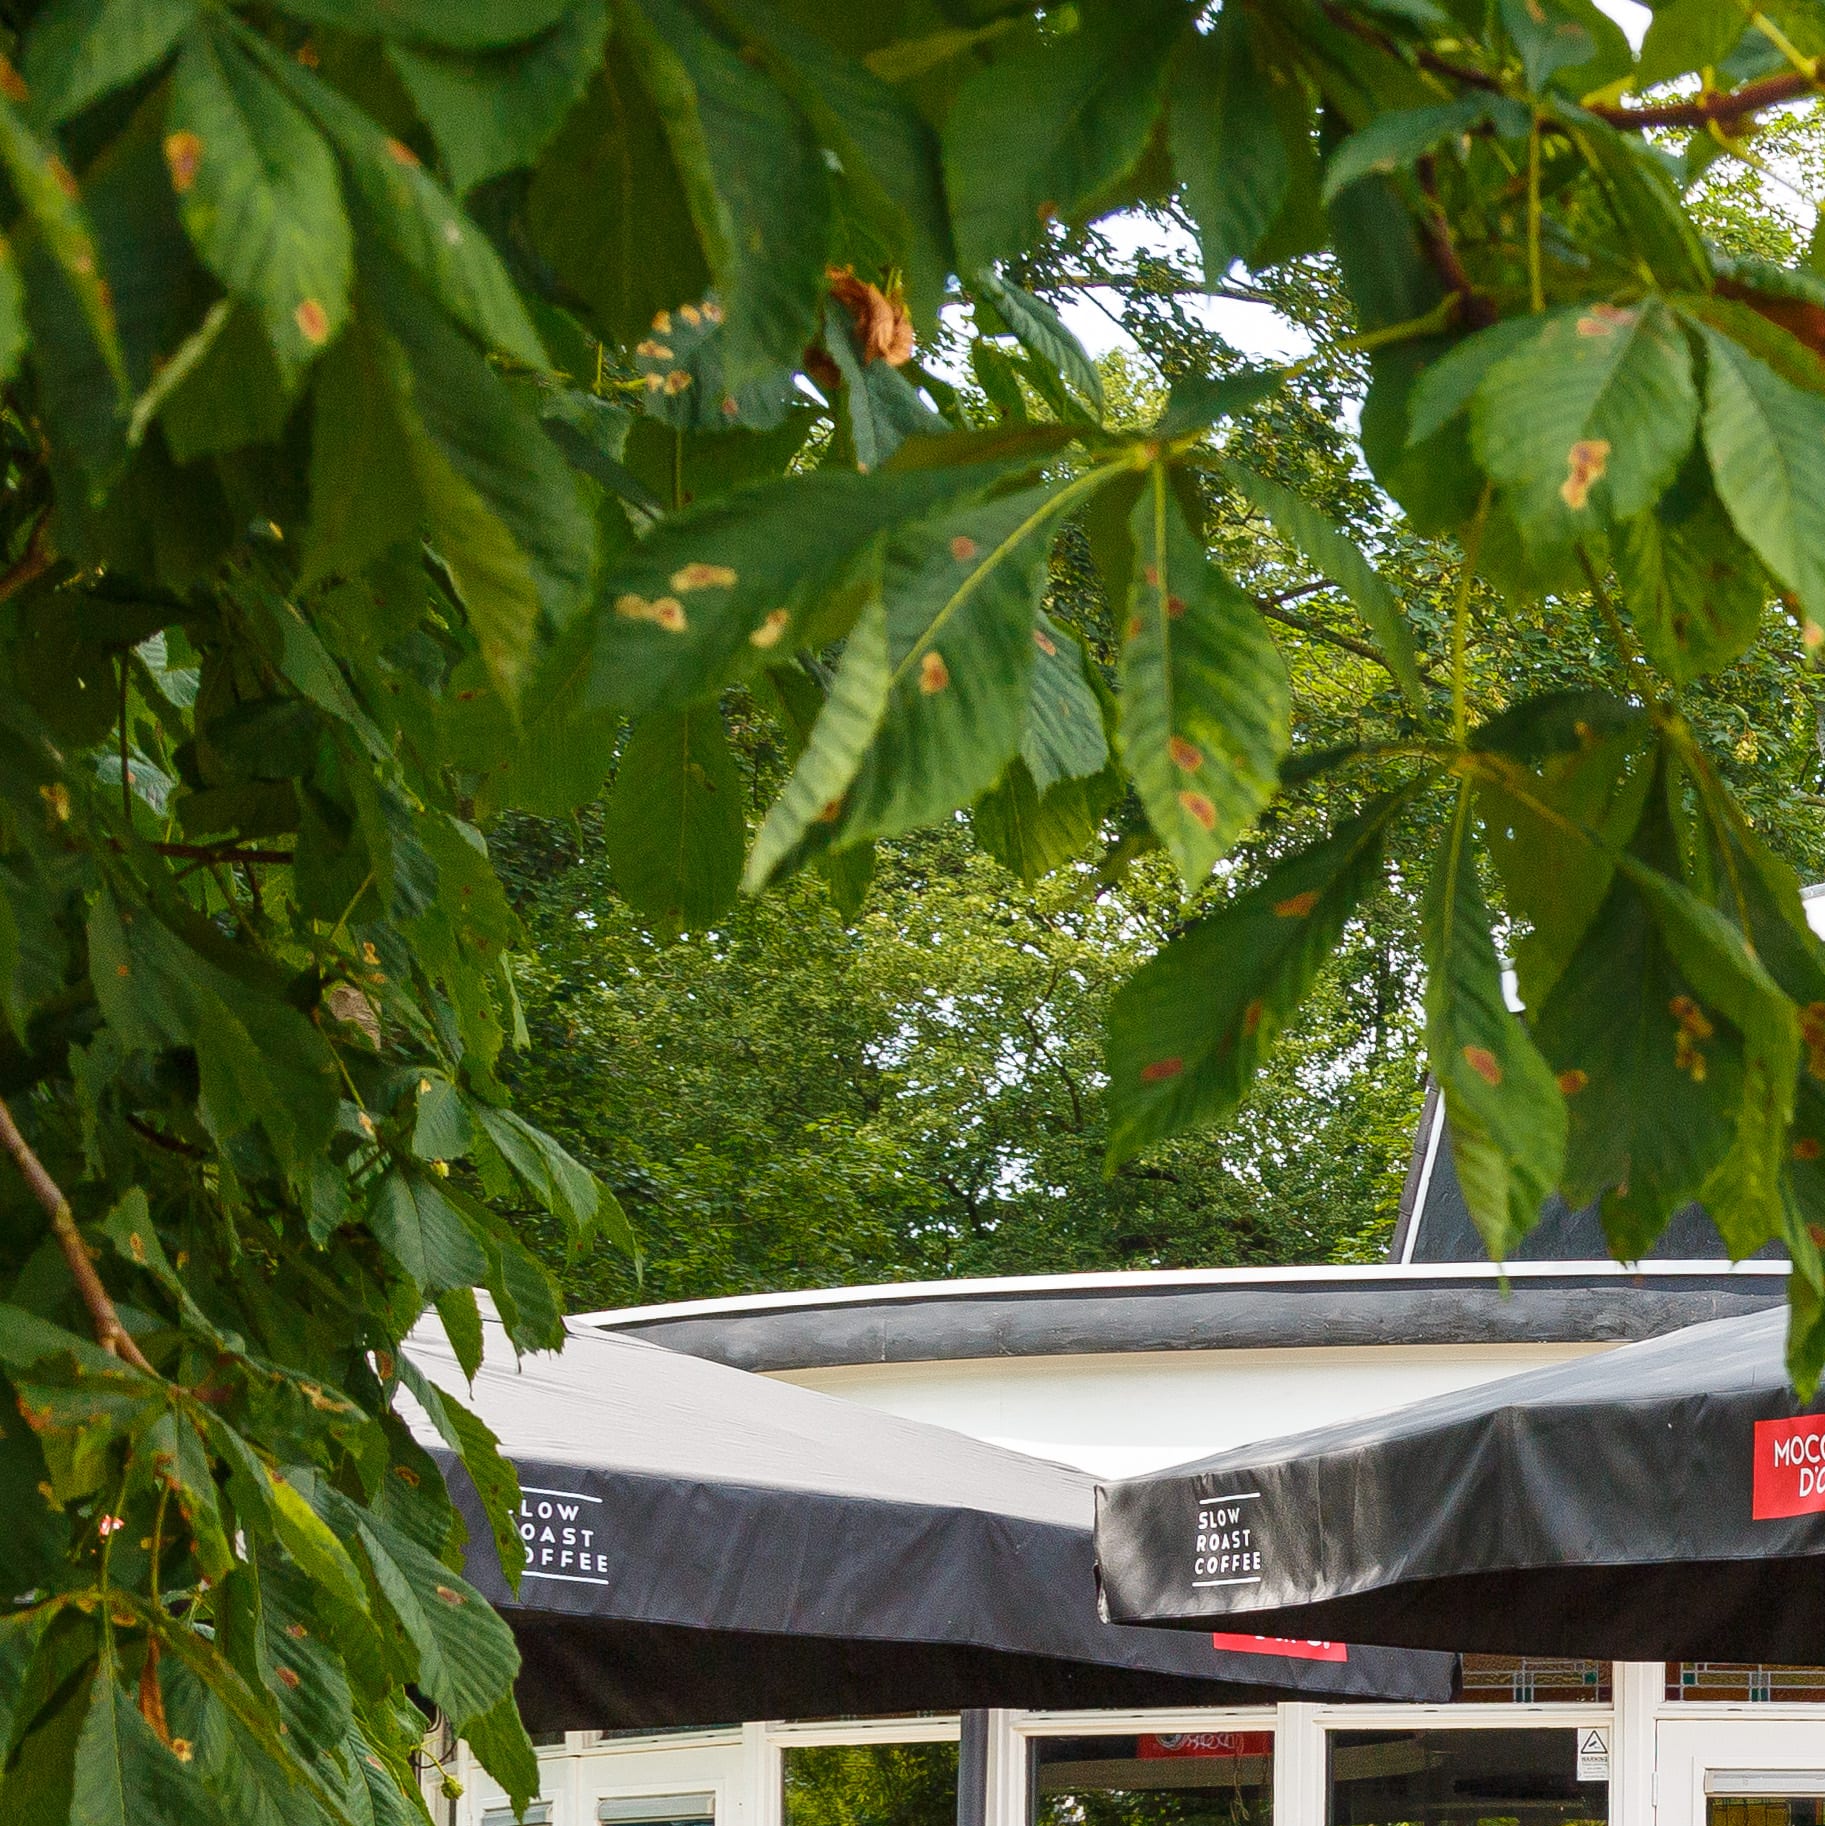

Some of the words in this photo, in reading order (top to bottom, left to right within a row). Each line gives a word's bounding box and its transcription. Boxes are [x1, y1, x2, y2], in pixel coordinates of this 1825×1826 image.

[508, 1499, 580, 1521] LOW
[1198, 1507, 1240, 1530] SLOW
[520, 1523, 594, 1547] OAST
[1196, 1529, 1251, 1552] ROAST
[523, 1546, 608, 1573] OFFEE
[1194, 1552, 1261, 1575] COFFEE
